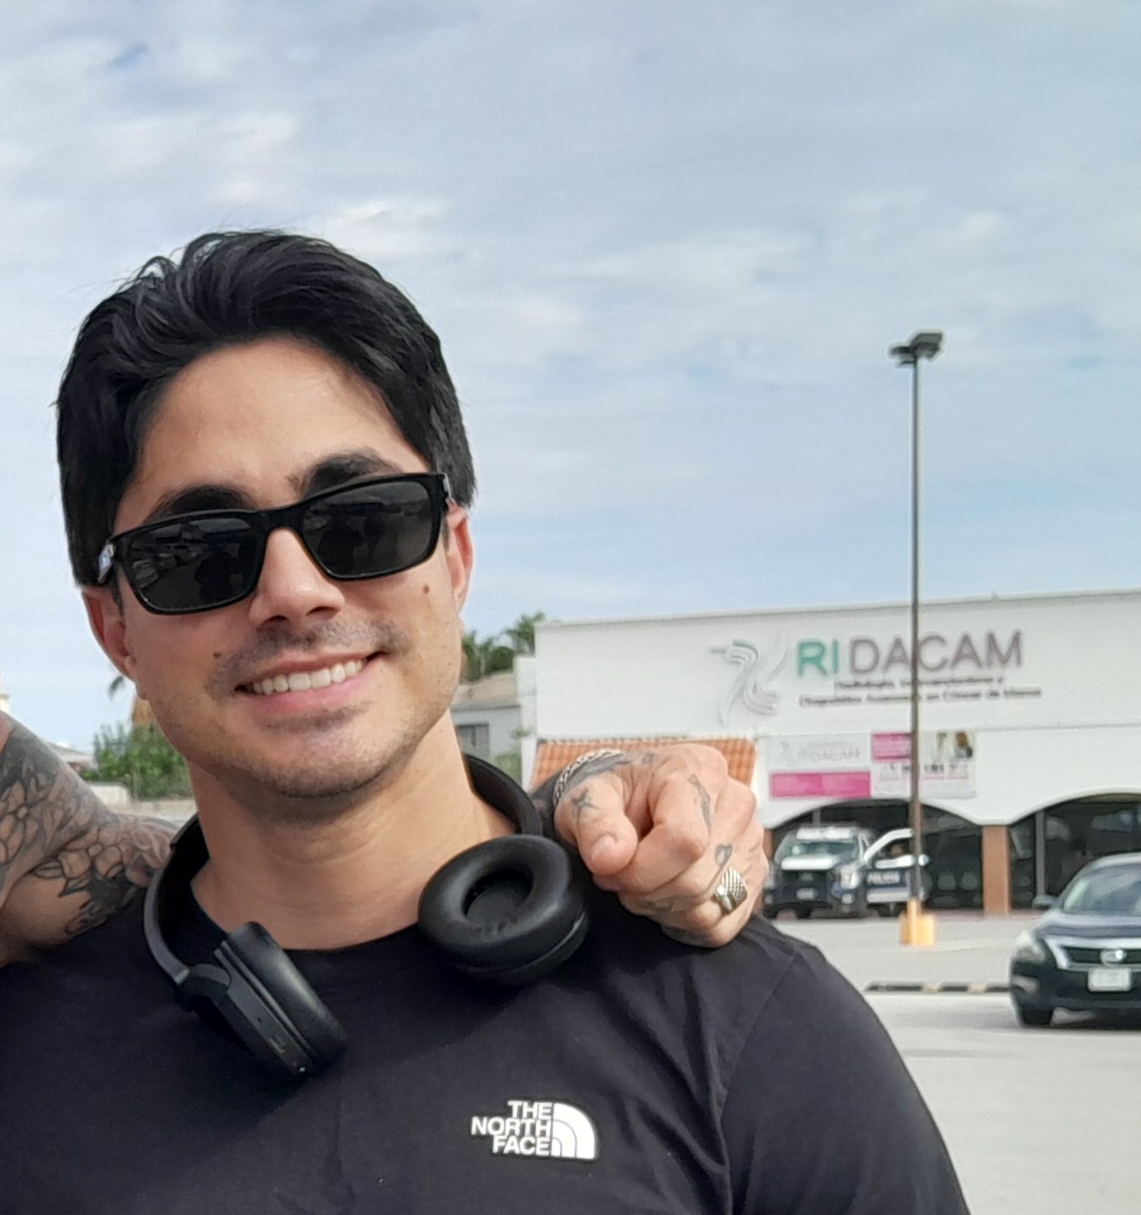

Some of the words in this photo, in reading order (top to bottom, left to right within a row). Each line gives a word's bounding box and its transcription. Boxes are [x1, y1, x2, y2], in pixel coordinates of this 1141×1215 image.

[507, 1100, 552, 1119] THE
[471, 1116, 552, 1137] NORTH
[492, 1135, 550, 1156] FACE
